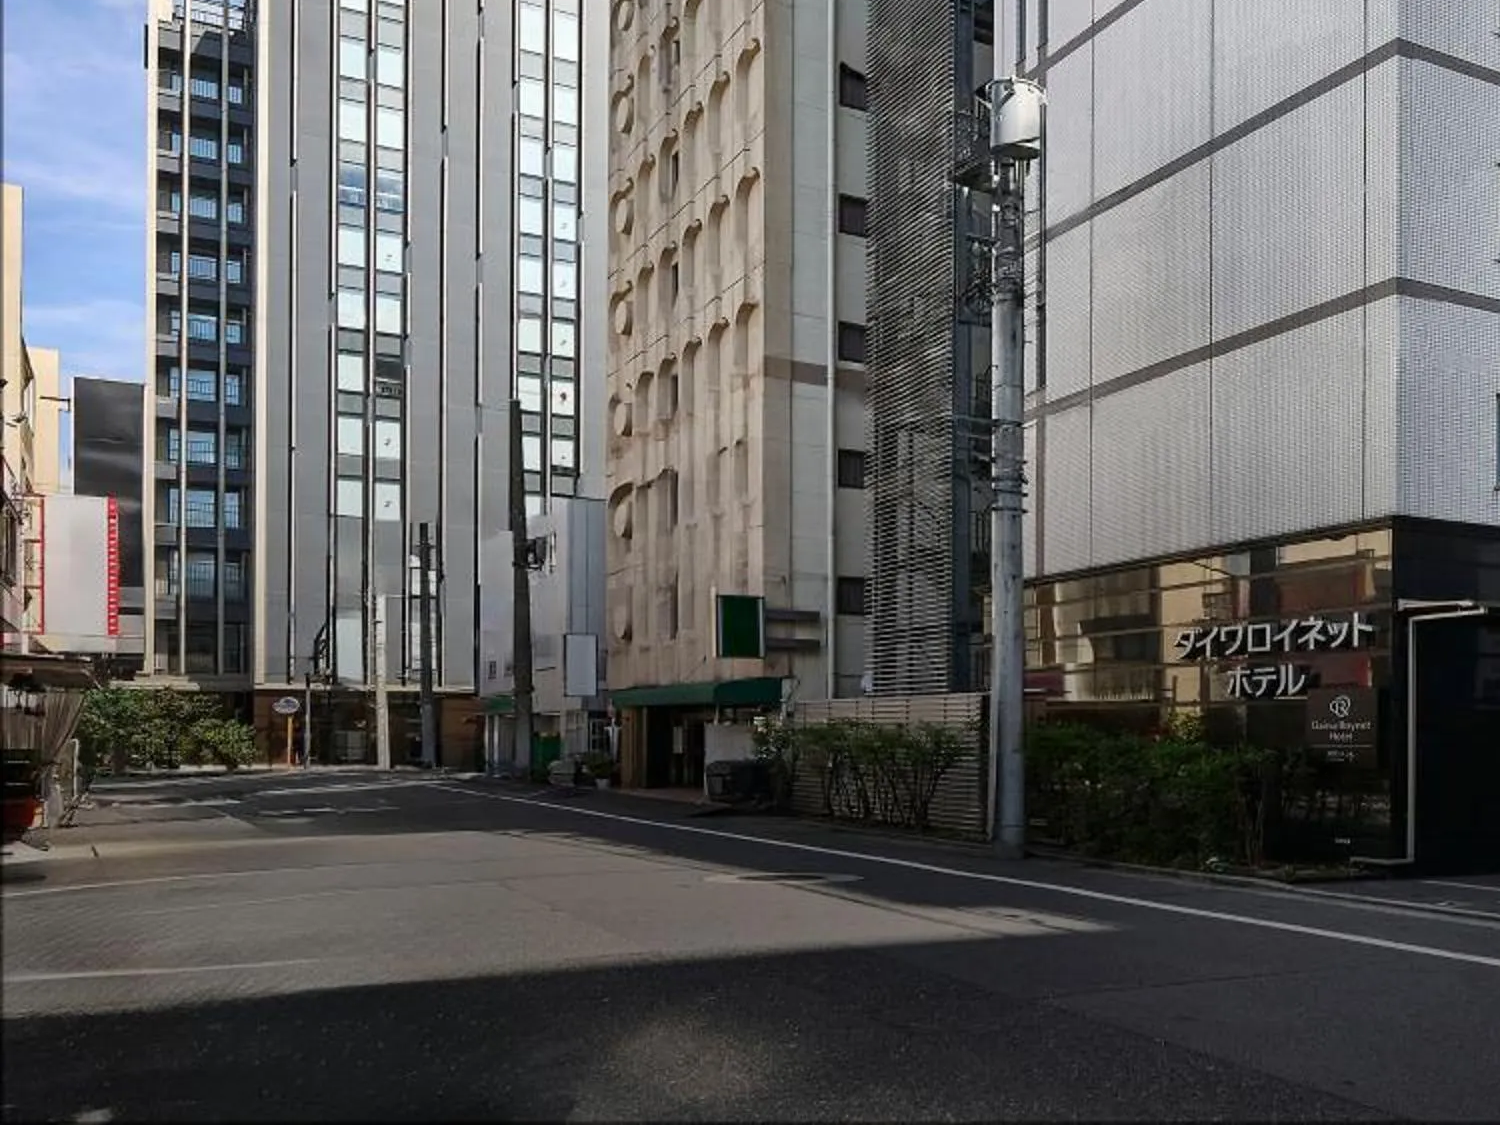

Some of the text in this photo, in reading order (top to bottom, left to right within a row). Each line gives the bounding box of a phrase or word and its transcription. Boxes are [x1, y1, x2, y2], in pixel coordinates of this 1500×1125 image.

[1174, 611, 1373, 660] ダイワロイネット
[1227, 663, 1306, 698] ホテル
